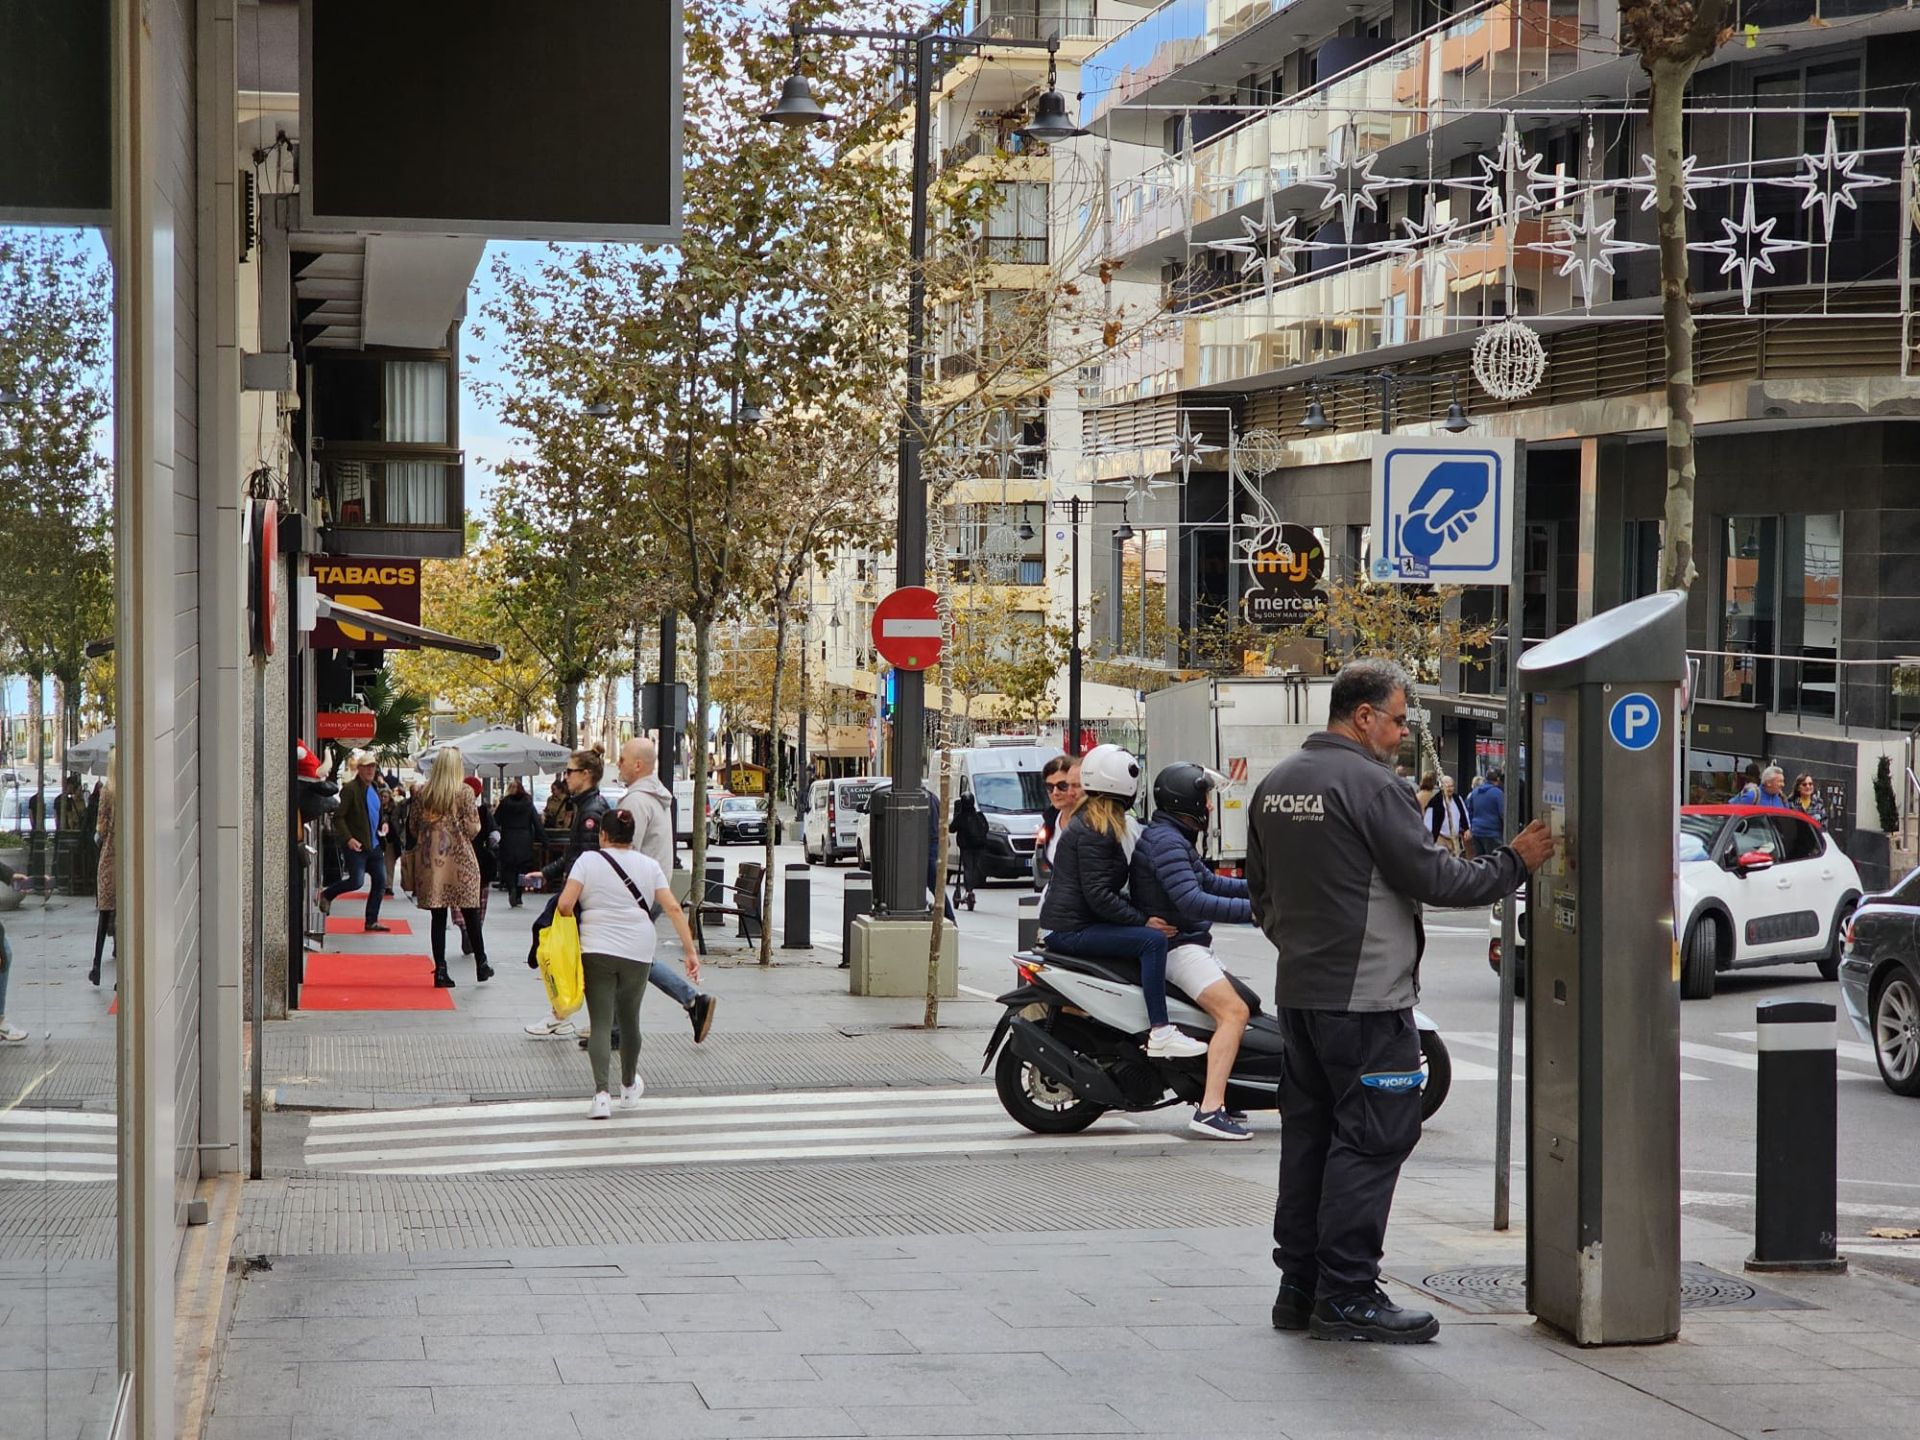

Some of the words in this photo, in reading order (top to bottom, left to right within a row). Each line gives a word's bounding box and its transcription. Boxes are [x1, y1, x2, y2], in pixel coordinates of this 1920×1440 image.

[313, 566, 415, 585] TABACS
[1257, 552, 1308, 582] my
[1254, 596, 1321, 610] mercat
[1454, 705, 1471, 715] LUXURY
[1472, 708, 1499, 719] PROPERTIES
[1625, 704, 1650, 739] P
